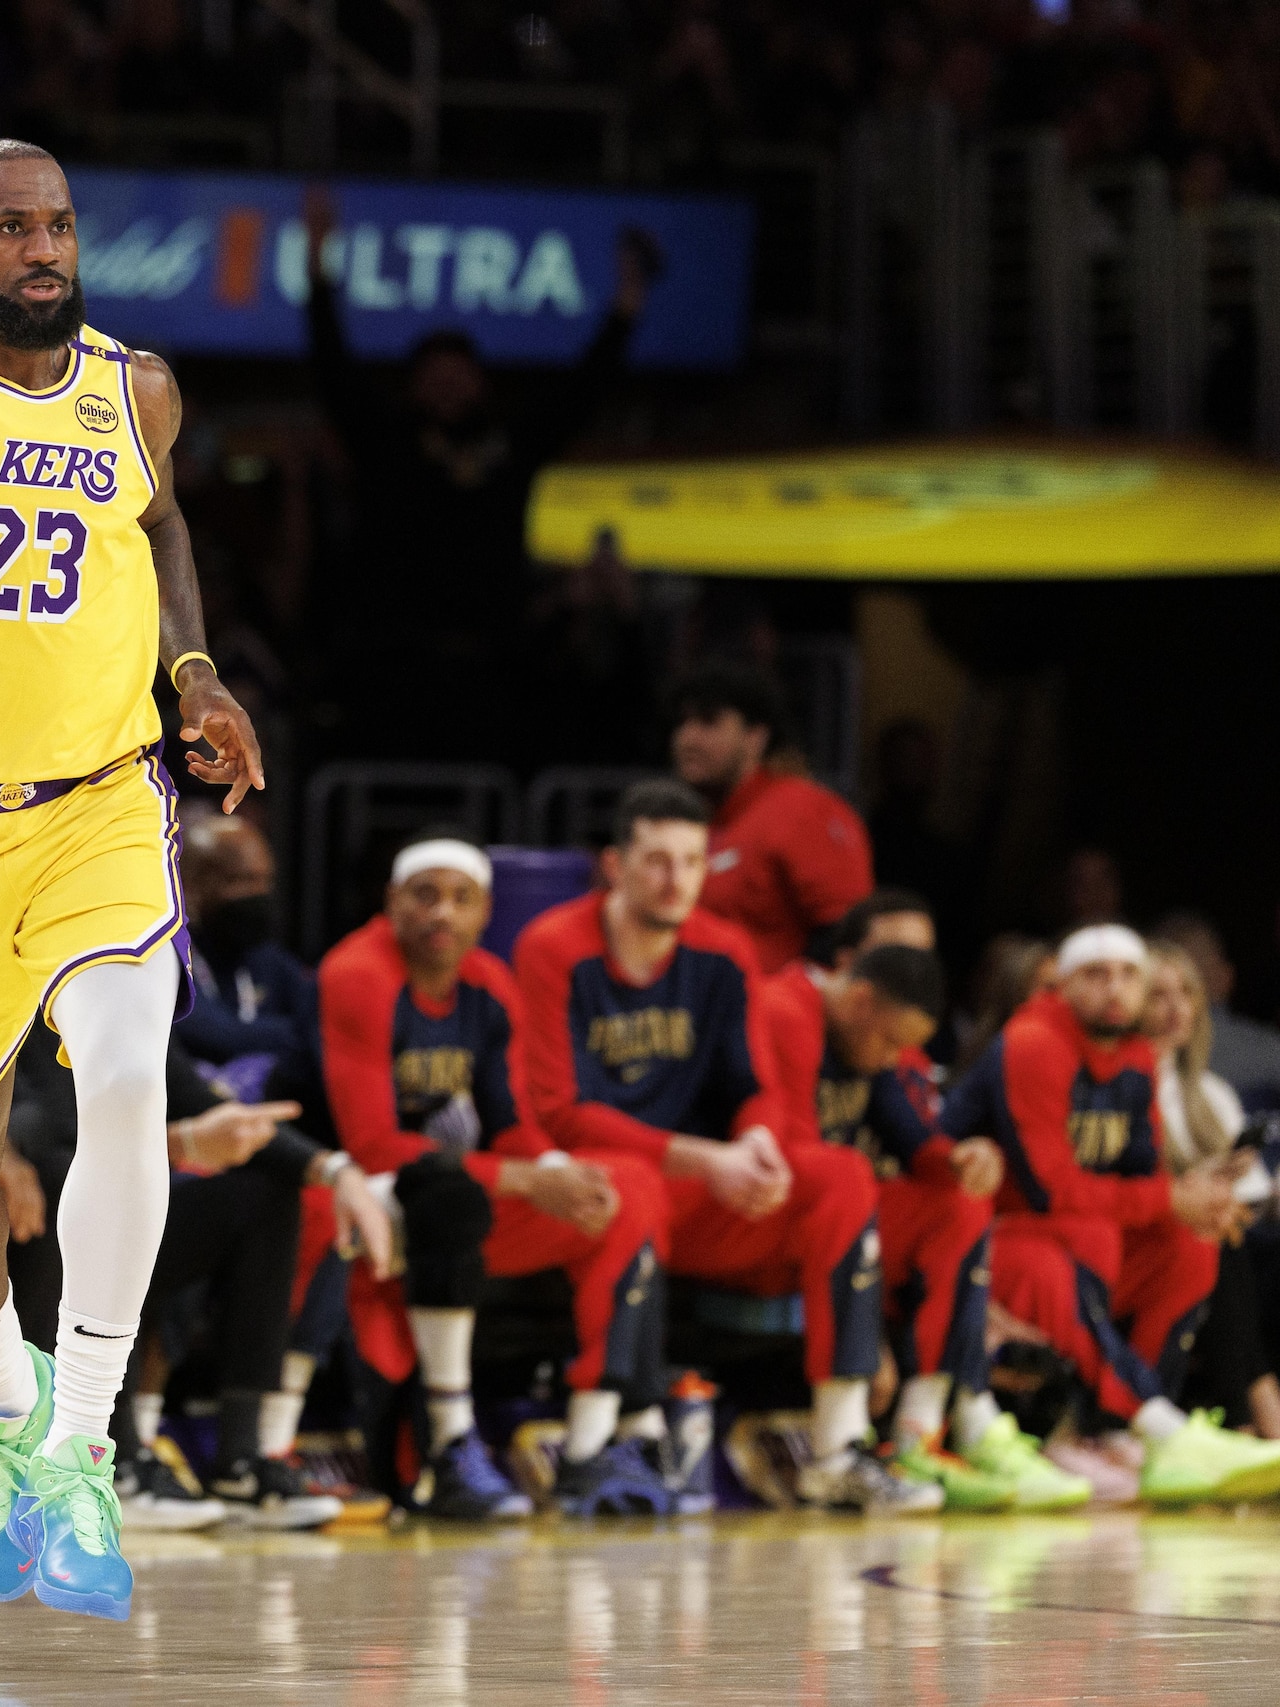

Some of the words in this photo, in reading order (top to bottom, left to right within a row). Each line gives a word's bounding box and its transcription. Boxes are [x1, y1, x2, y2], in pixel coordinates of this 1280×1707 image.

[275, 221, 584, 316] ULTRA
[92, 346, 106, 359] 44
[79, 403, 115, 423] bibigo
